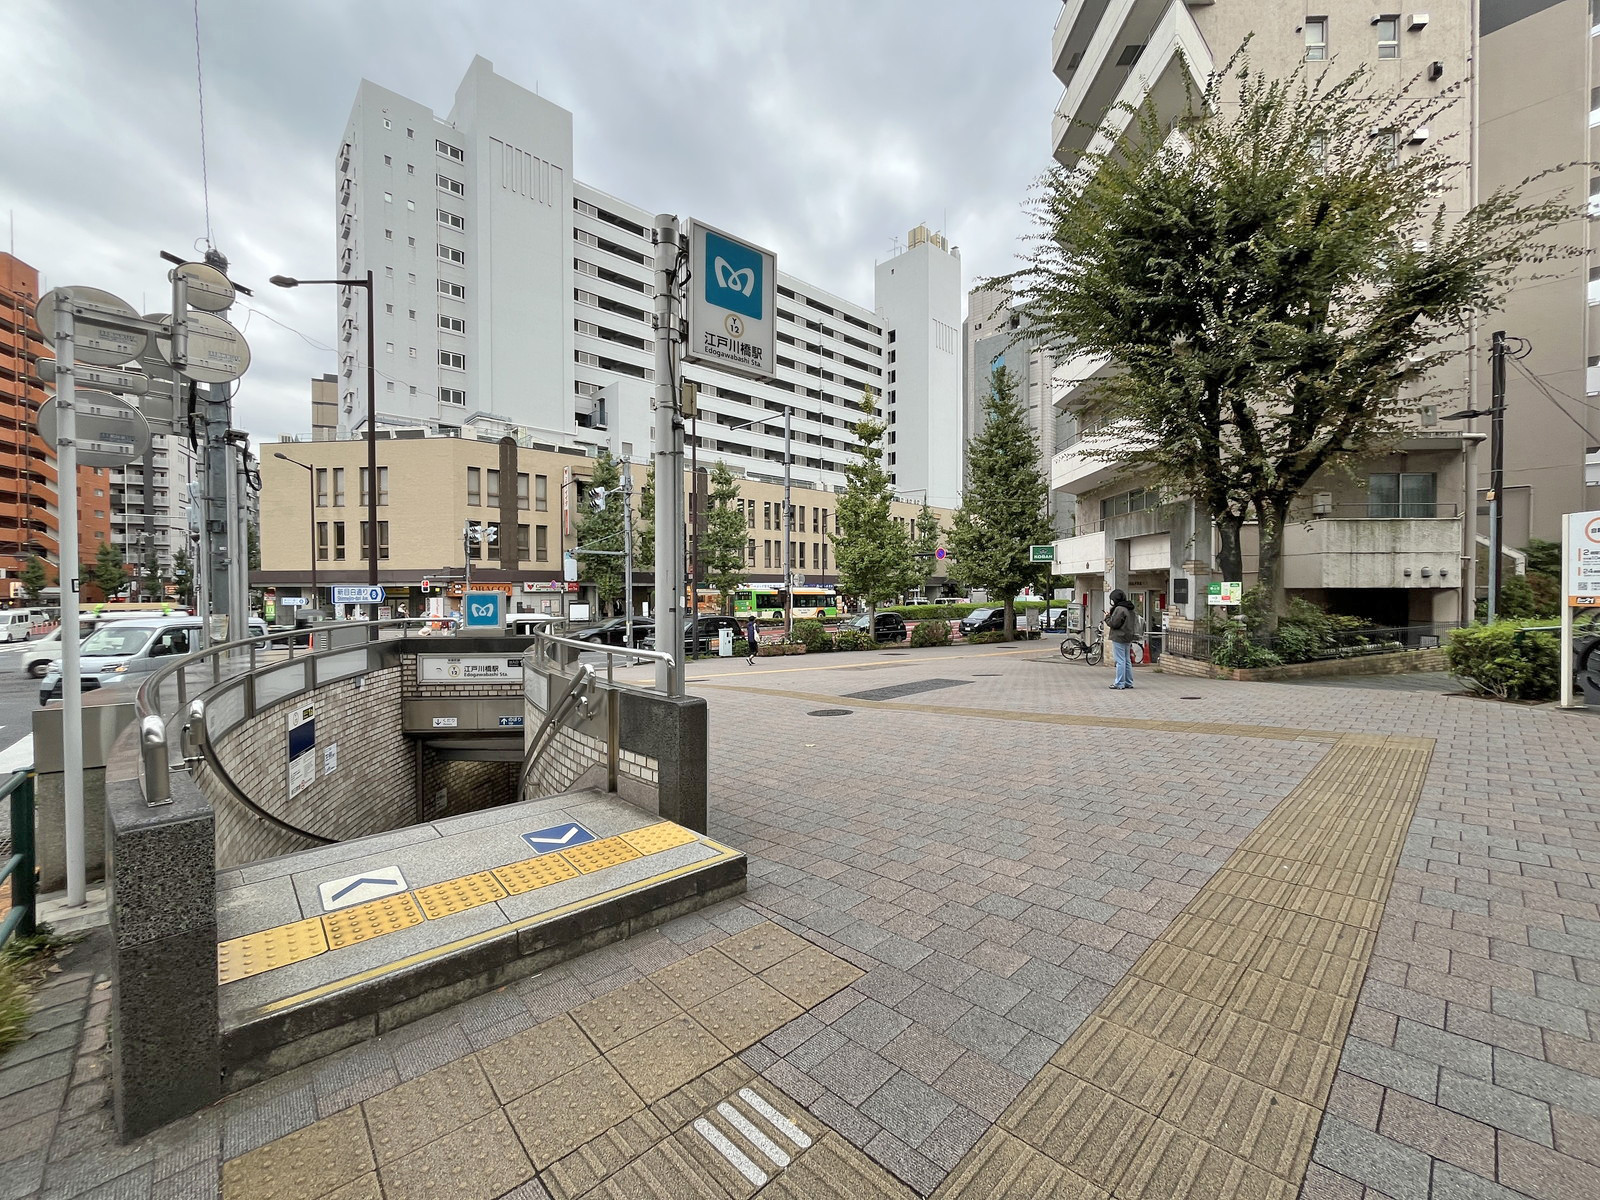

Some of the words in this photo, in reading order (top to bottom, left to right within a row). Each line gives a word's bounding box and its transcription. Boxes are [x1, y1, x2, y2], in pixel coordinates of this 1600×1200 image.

[731, 325, 740, 333] 12
[705, 331, 762, 360] 江戸川橋駅
[705, 346, 749, 364] Edogawabashi
[751, 359, 762, 368] Sta.
[466, 585, 510, 593] OBACCO
